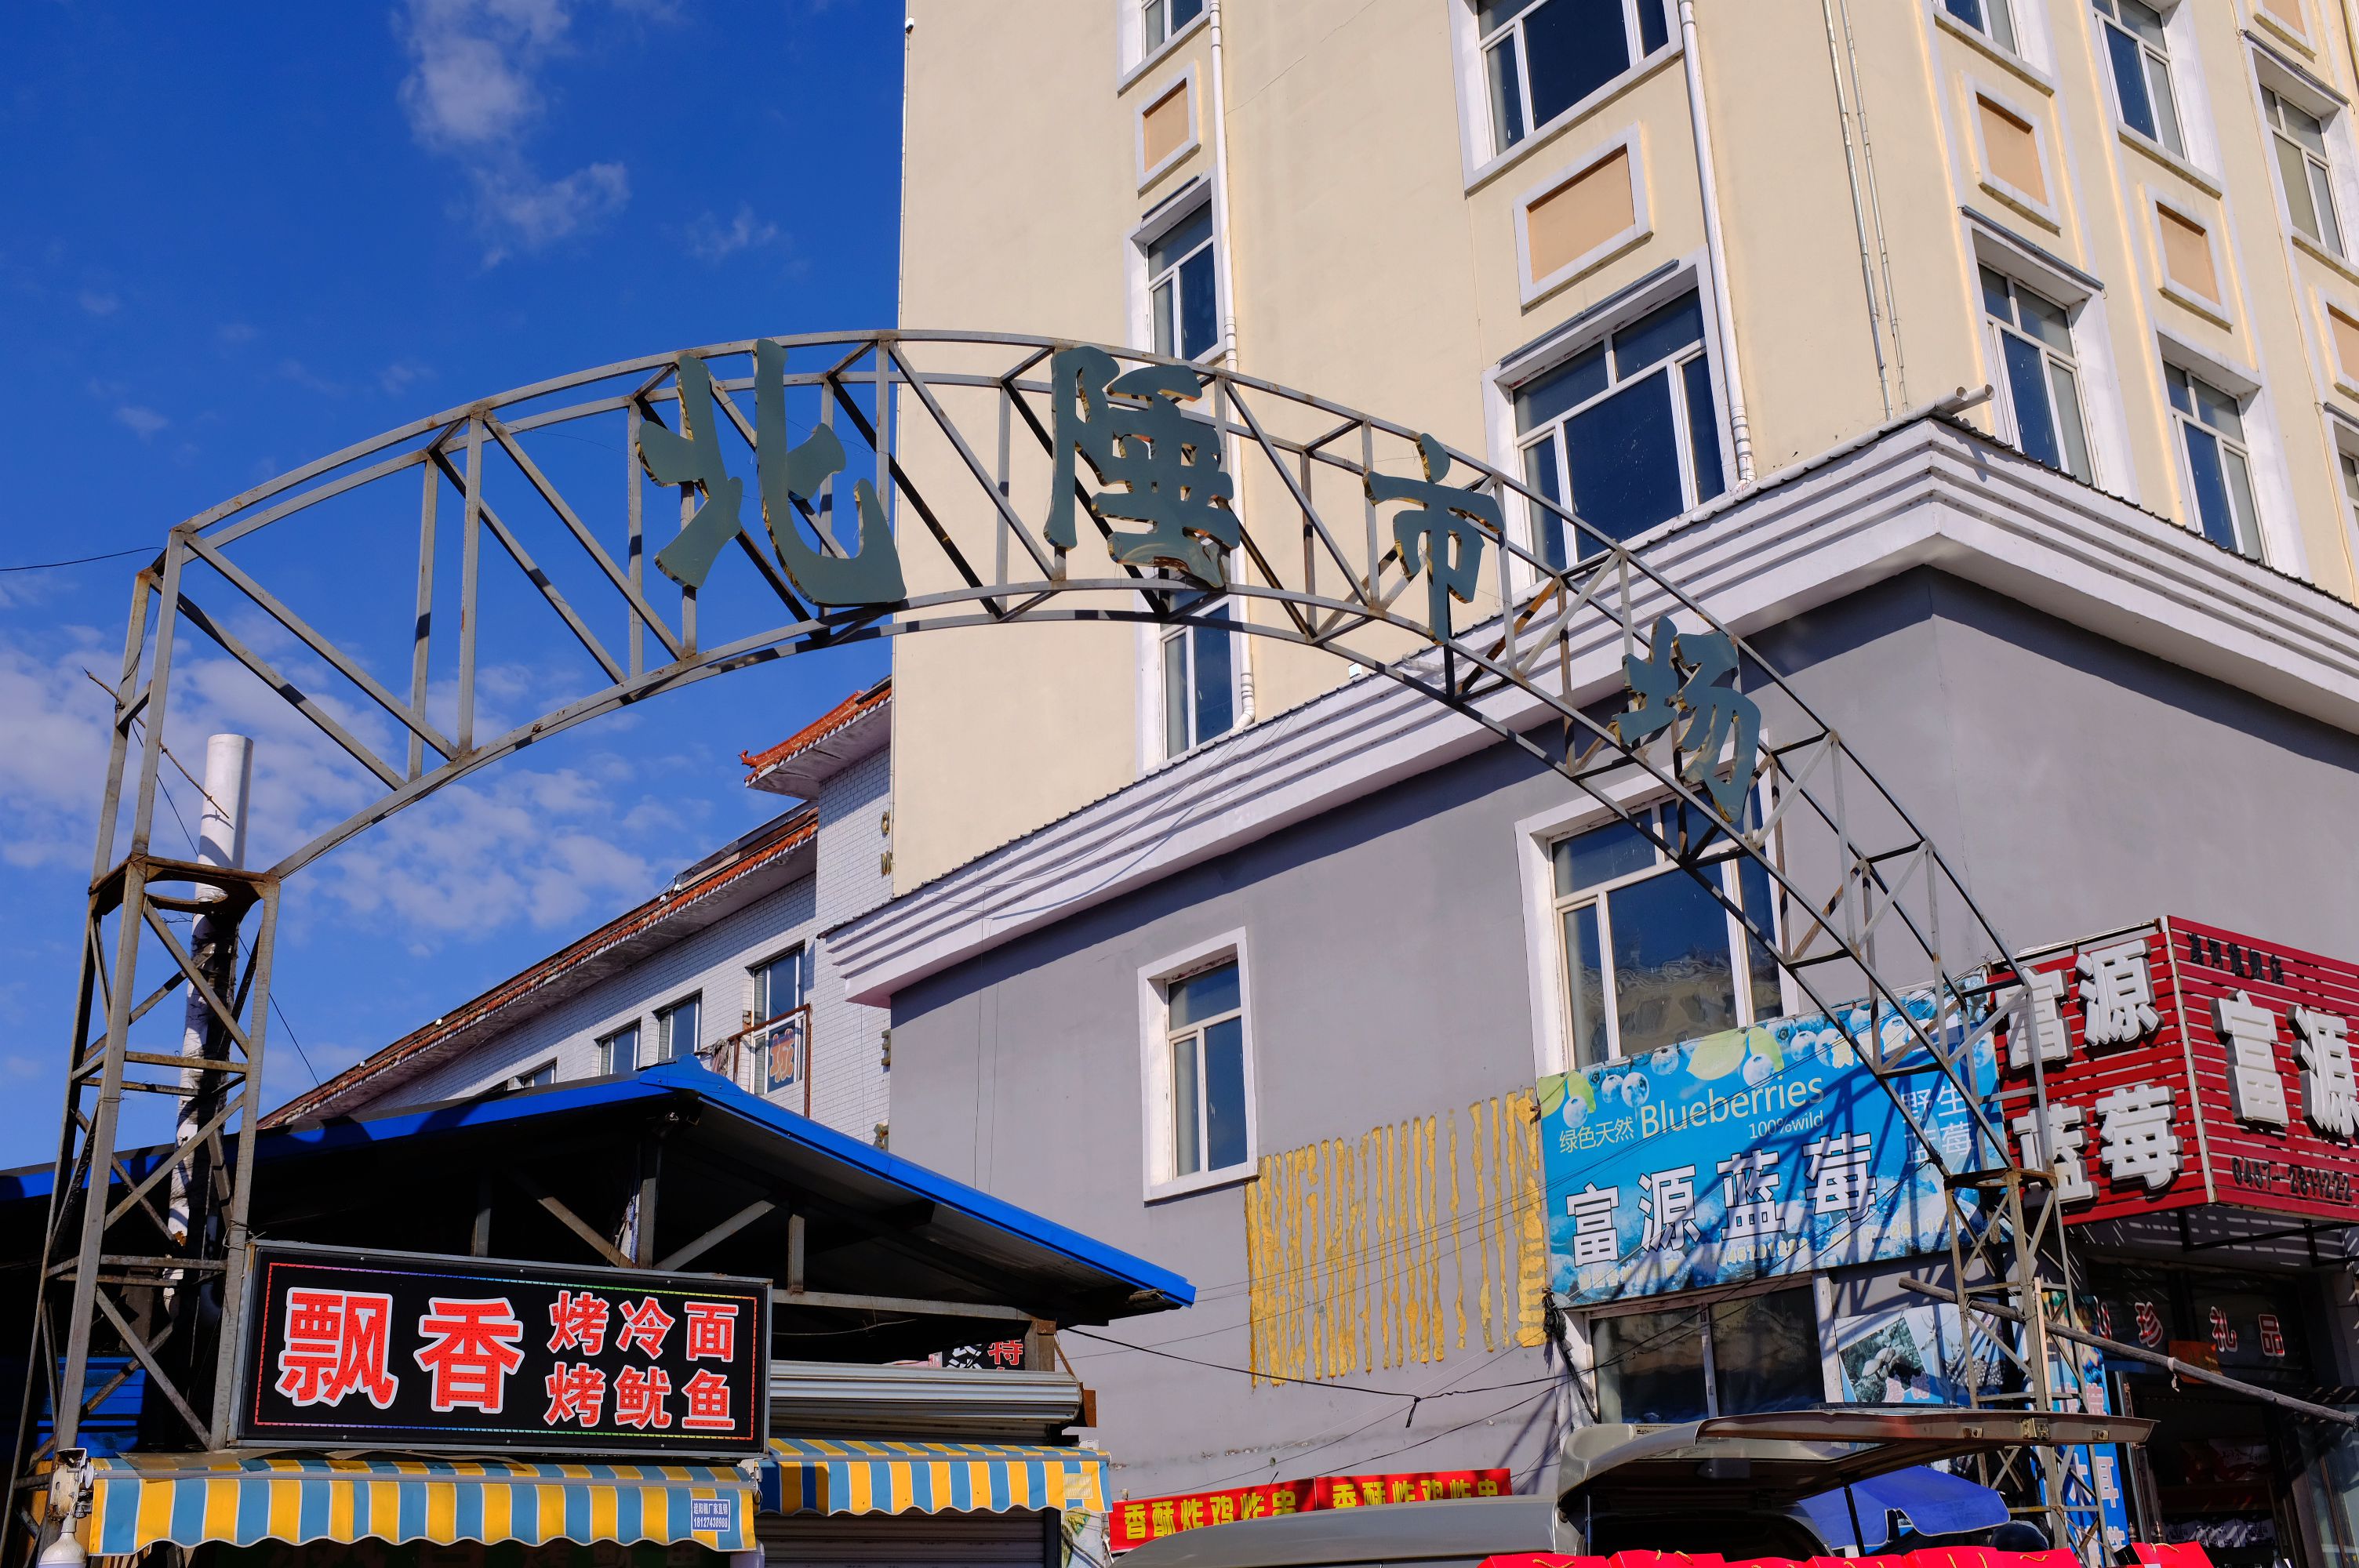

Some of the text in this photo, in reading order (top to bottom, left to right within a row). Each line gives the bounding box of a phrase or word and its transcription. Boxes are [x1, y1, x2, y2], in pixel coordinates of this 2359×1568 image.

[1995, 938, 2163, 1070] 富源
[1641, 1075, 1825, 1139] Blueberries
[2209, 989, 2359, 1138] 富源
[1559, 1116, 1634, 1154] 绿色天然
[1566, 1131, 1877, 1267] 富源蓝莓
[274, 1287, 525, 1413] 飘香
[547, 1290, 740, 1363] 烤冷面
[544, 1362, 736, 1430] 烤鱿鱼
